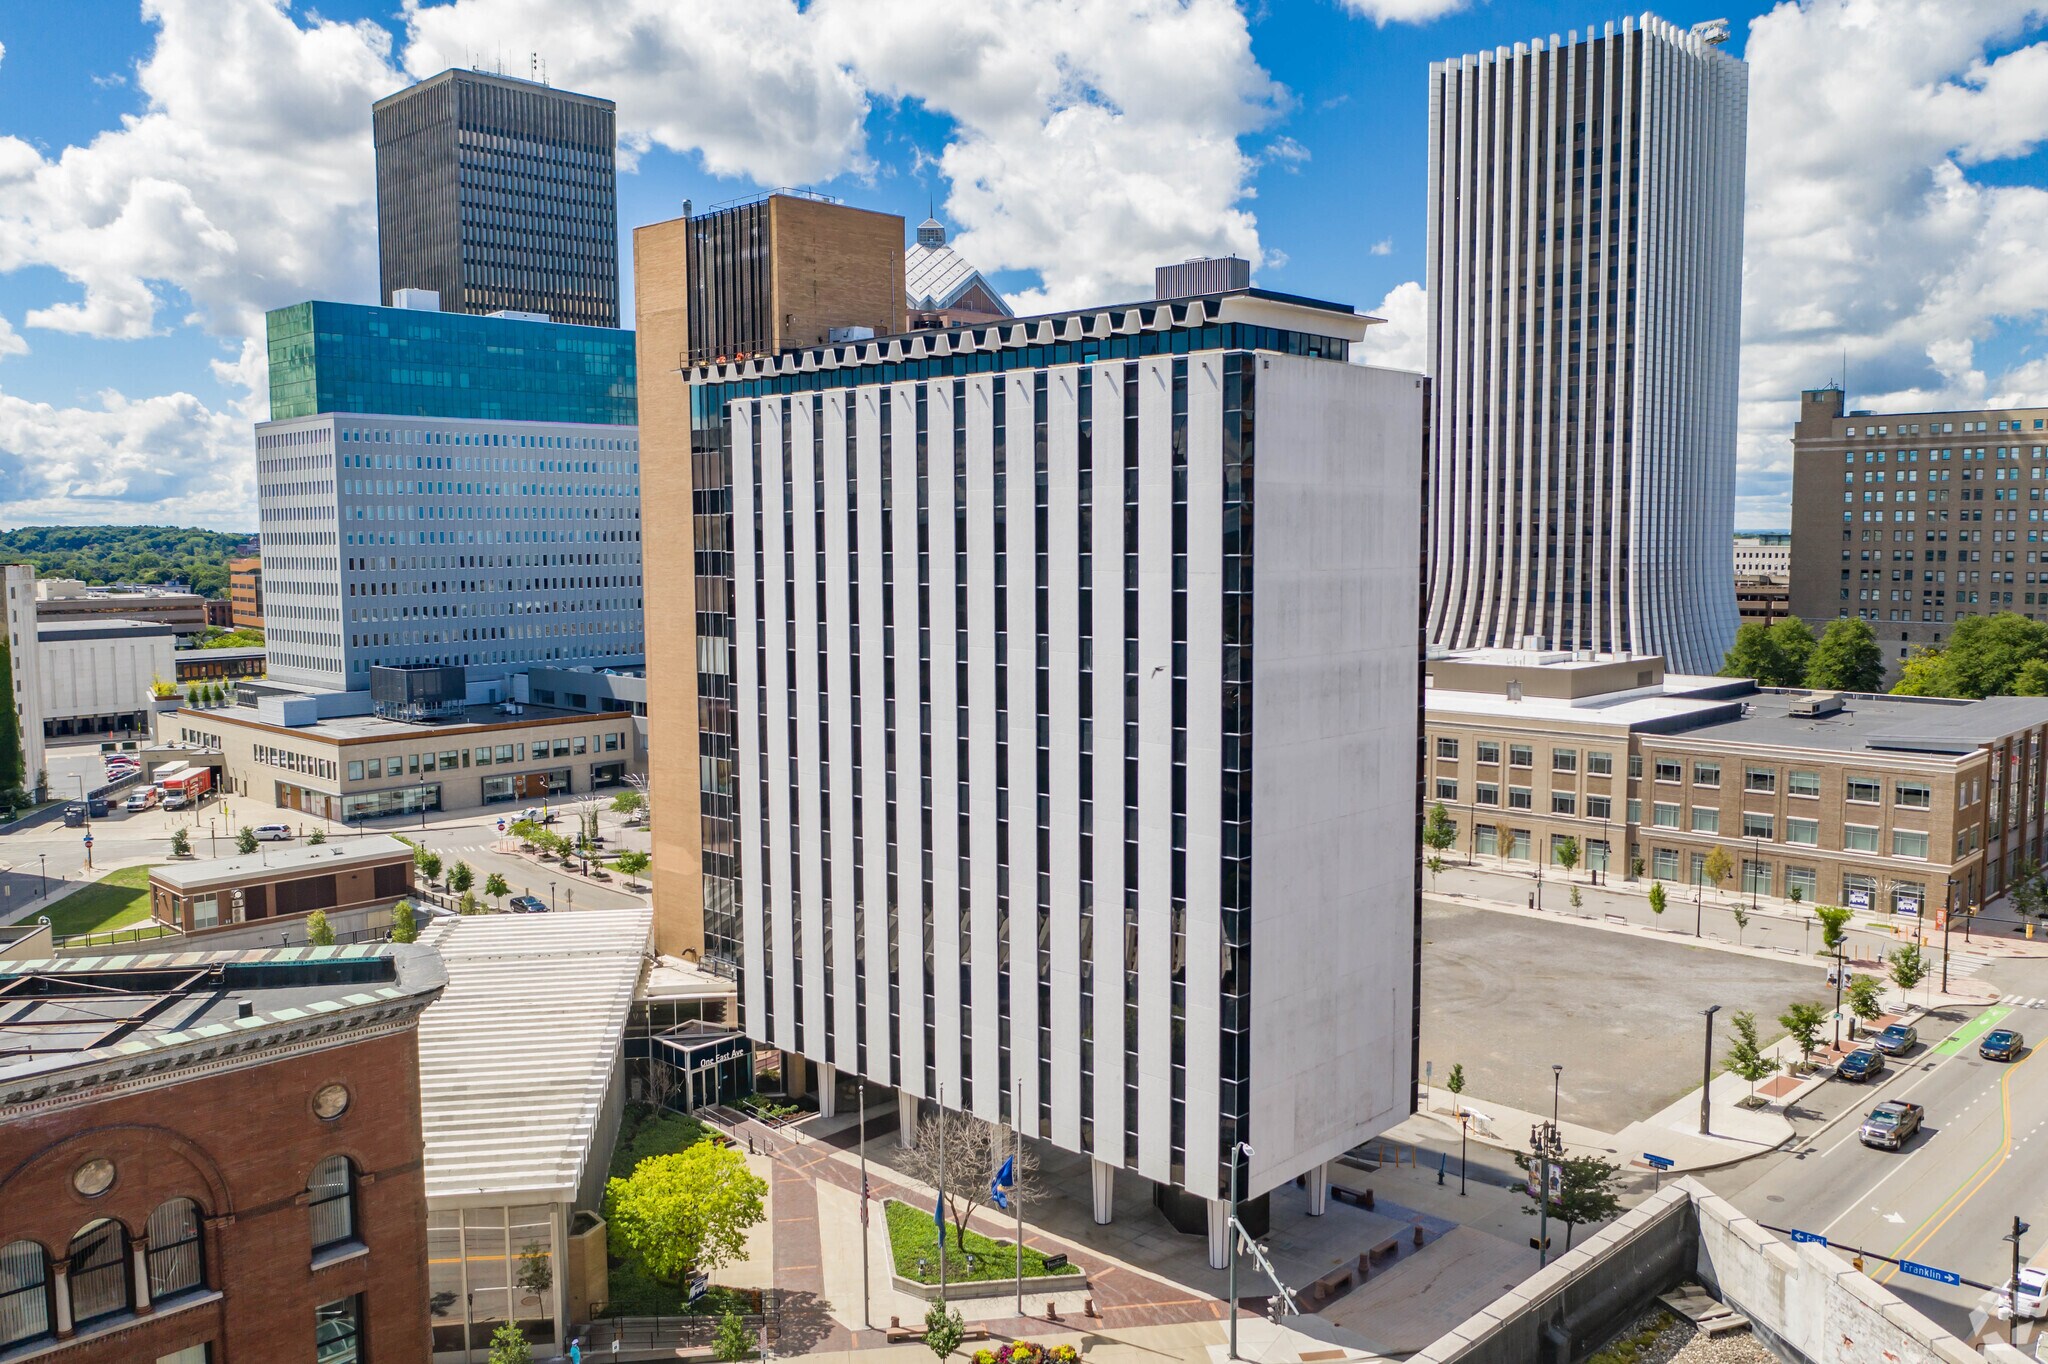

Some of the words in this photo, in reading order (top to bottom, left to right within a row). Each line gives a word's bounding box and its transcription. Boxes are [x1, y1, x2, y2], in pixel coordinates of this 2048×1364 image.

[715, 1052, 730, 1063] East
[731, 1049, 744, 1058] Ave
[1903, 1262, 1941, 1280] Franklin
